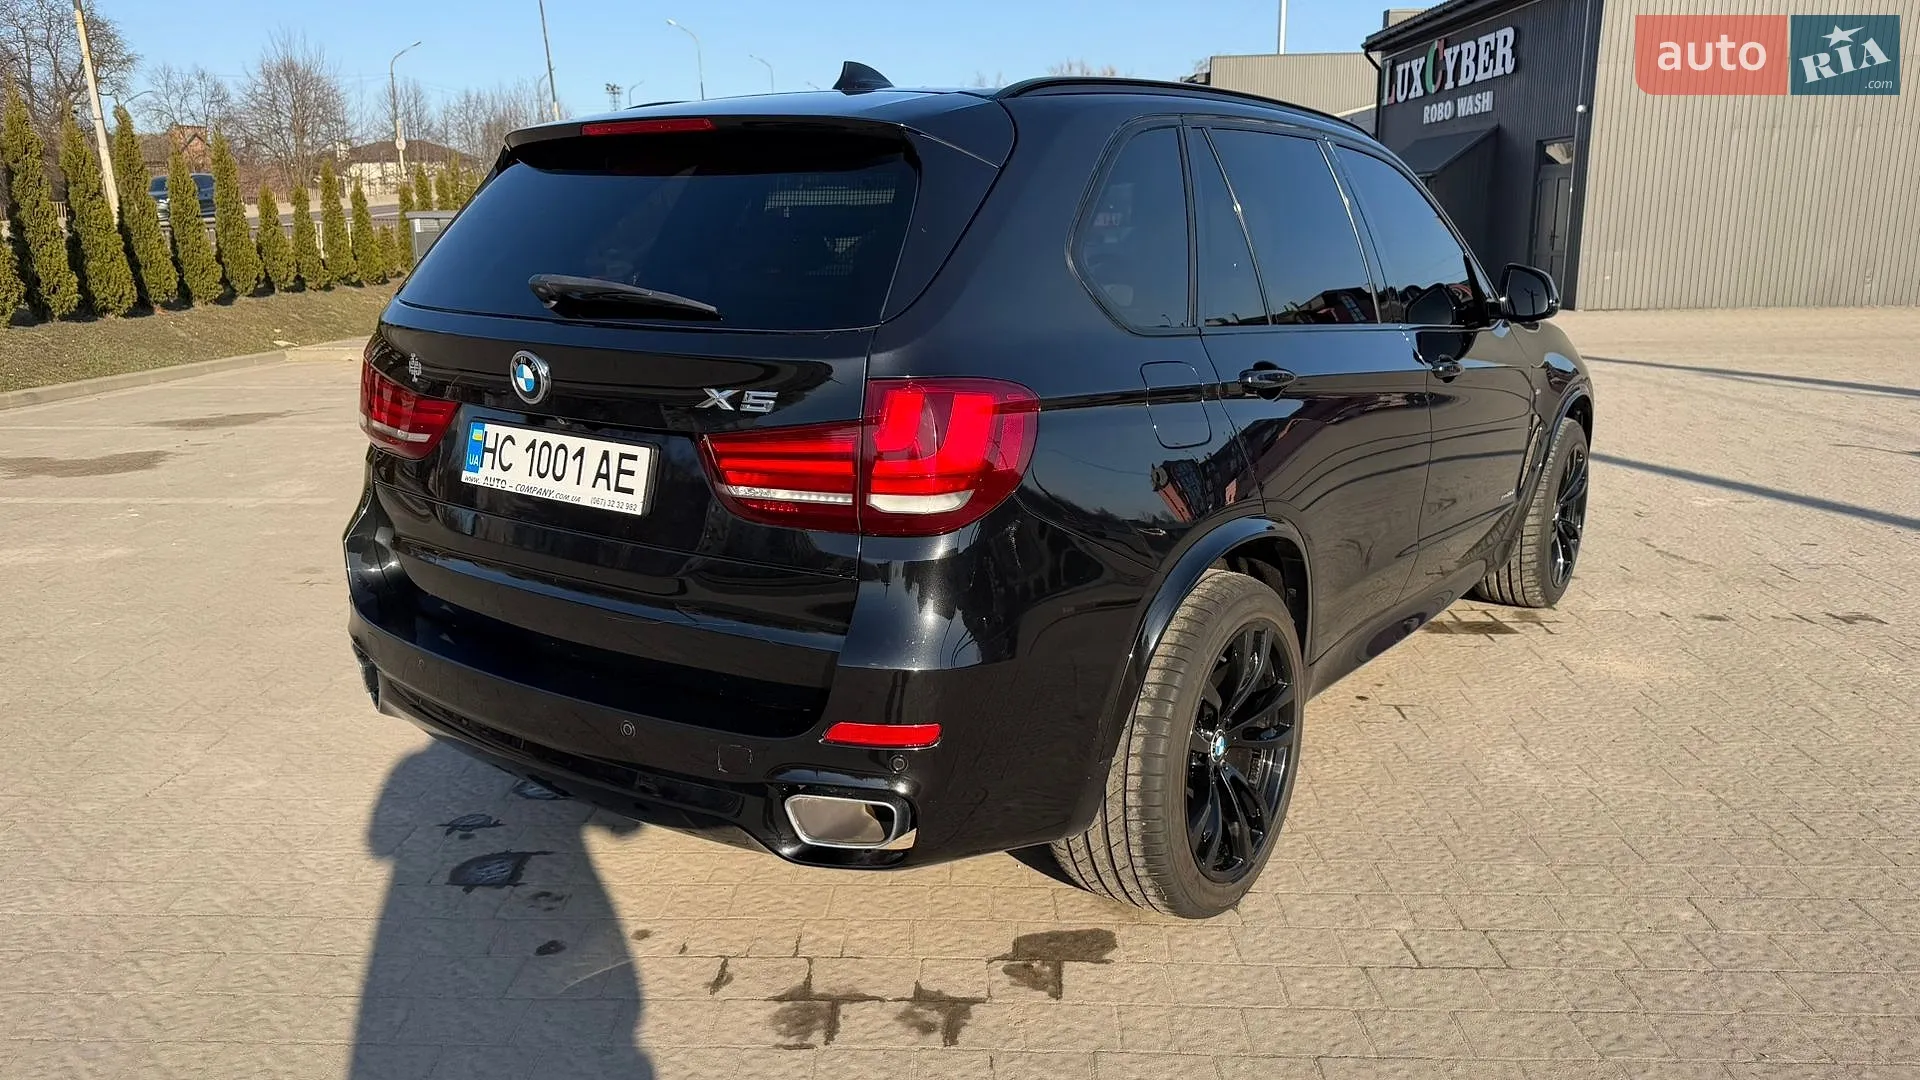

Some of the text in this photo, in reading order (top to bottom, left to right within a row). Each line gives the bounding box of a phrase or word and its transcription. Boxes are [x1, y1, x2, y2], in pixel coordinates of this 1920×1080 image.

[1423, 91, 1494, 125] ROBO WASH
[694, 387, 779, 413] X5
[469, 455, 480, 466] UA
[479, 430, 639, 496] HC 1001 AE
[483, 476, 507, 489] AUTO
